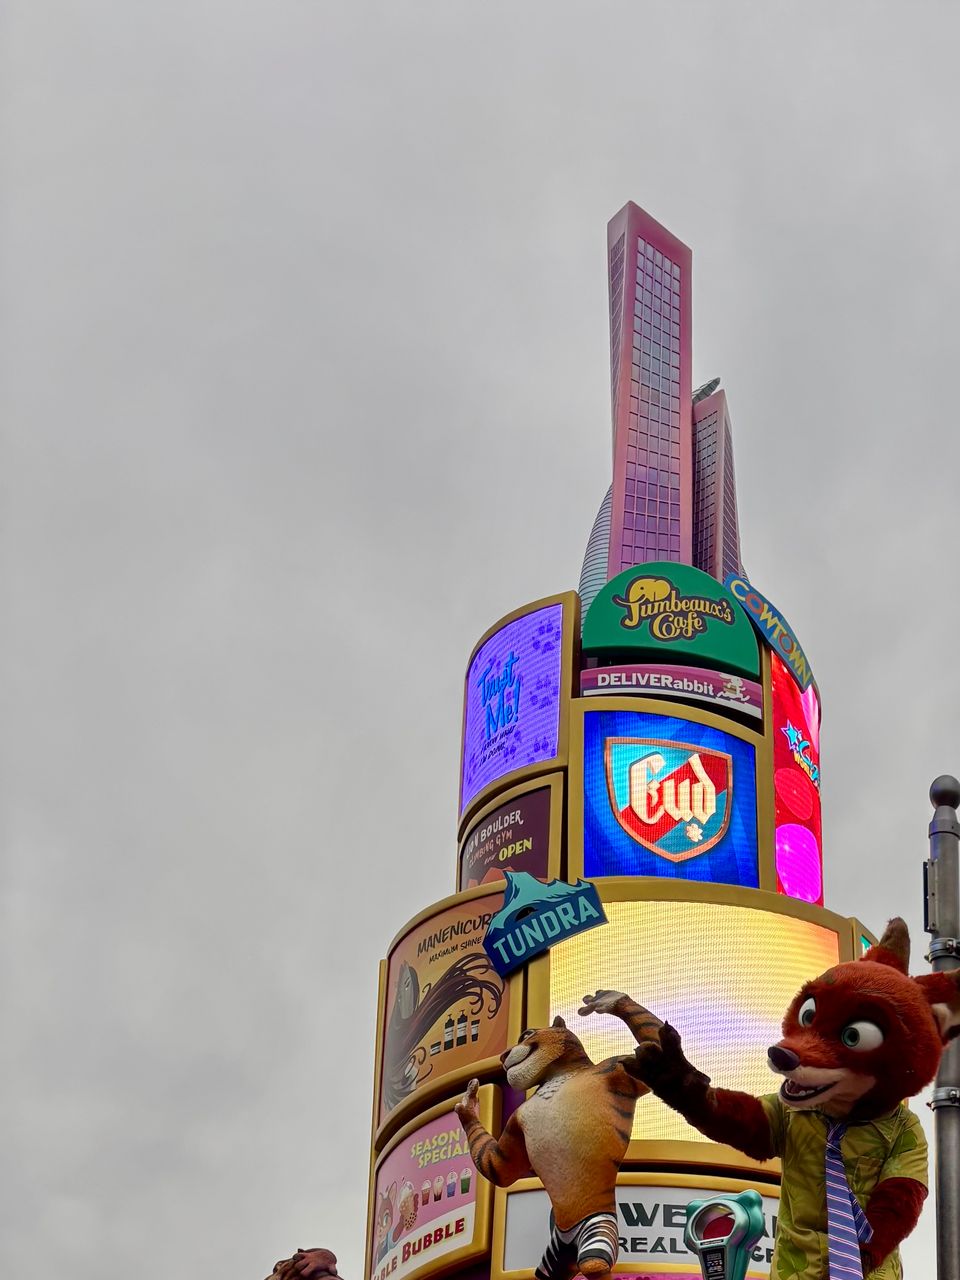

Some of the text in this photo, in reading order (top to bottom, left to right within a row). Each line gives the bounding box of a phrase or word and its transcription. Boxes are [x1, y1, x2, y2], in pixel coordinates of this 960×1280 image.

[730, 579, 813, 687] COWTOWN
[477, 650, 520, 708] Trust
[597, 672, 715, 696] DELIVERabbit
[480, 809, 525, 842] BOULDER
[496, 829, 513, 846] GYM
[498, 837, 533, 862] OPEN
[492, 895, 600, 964] TUNDRA
[429, 936, 482, 964] MAXIMUM SHINE
[401, 1217, 465, 1264] BUBBLE
